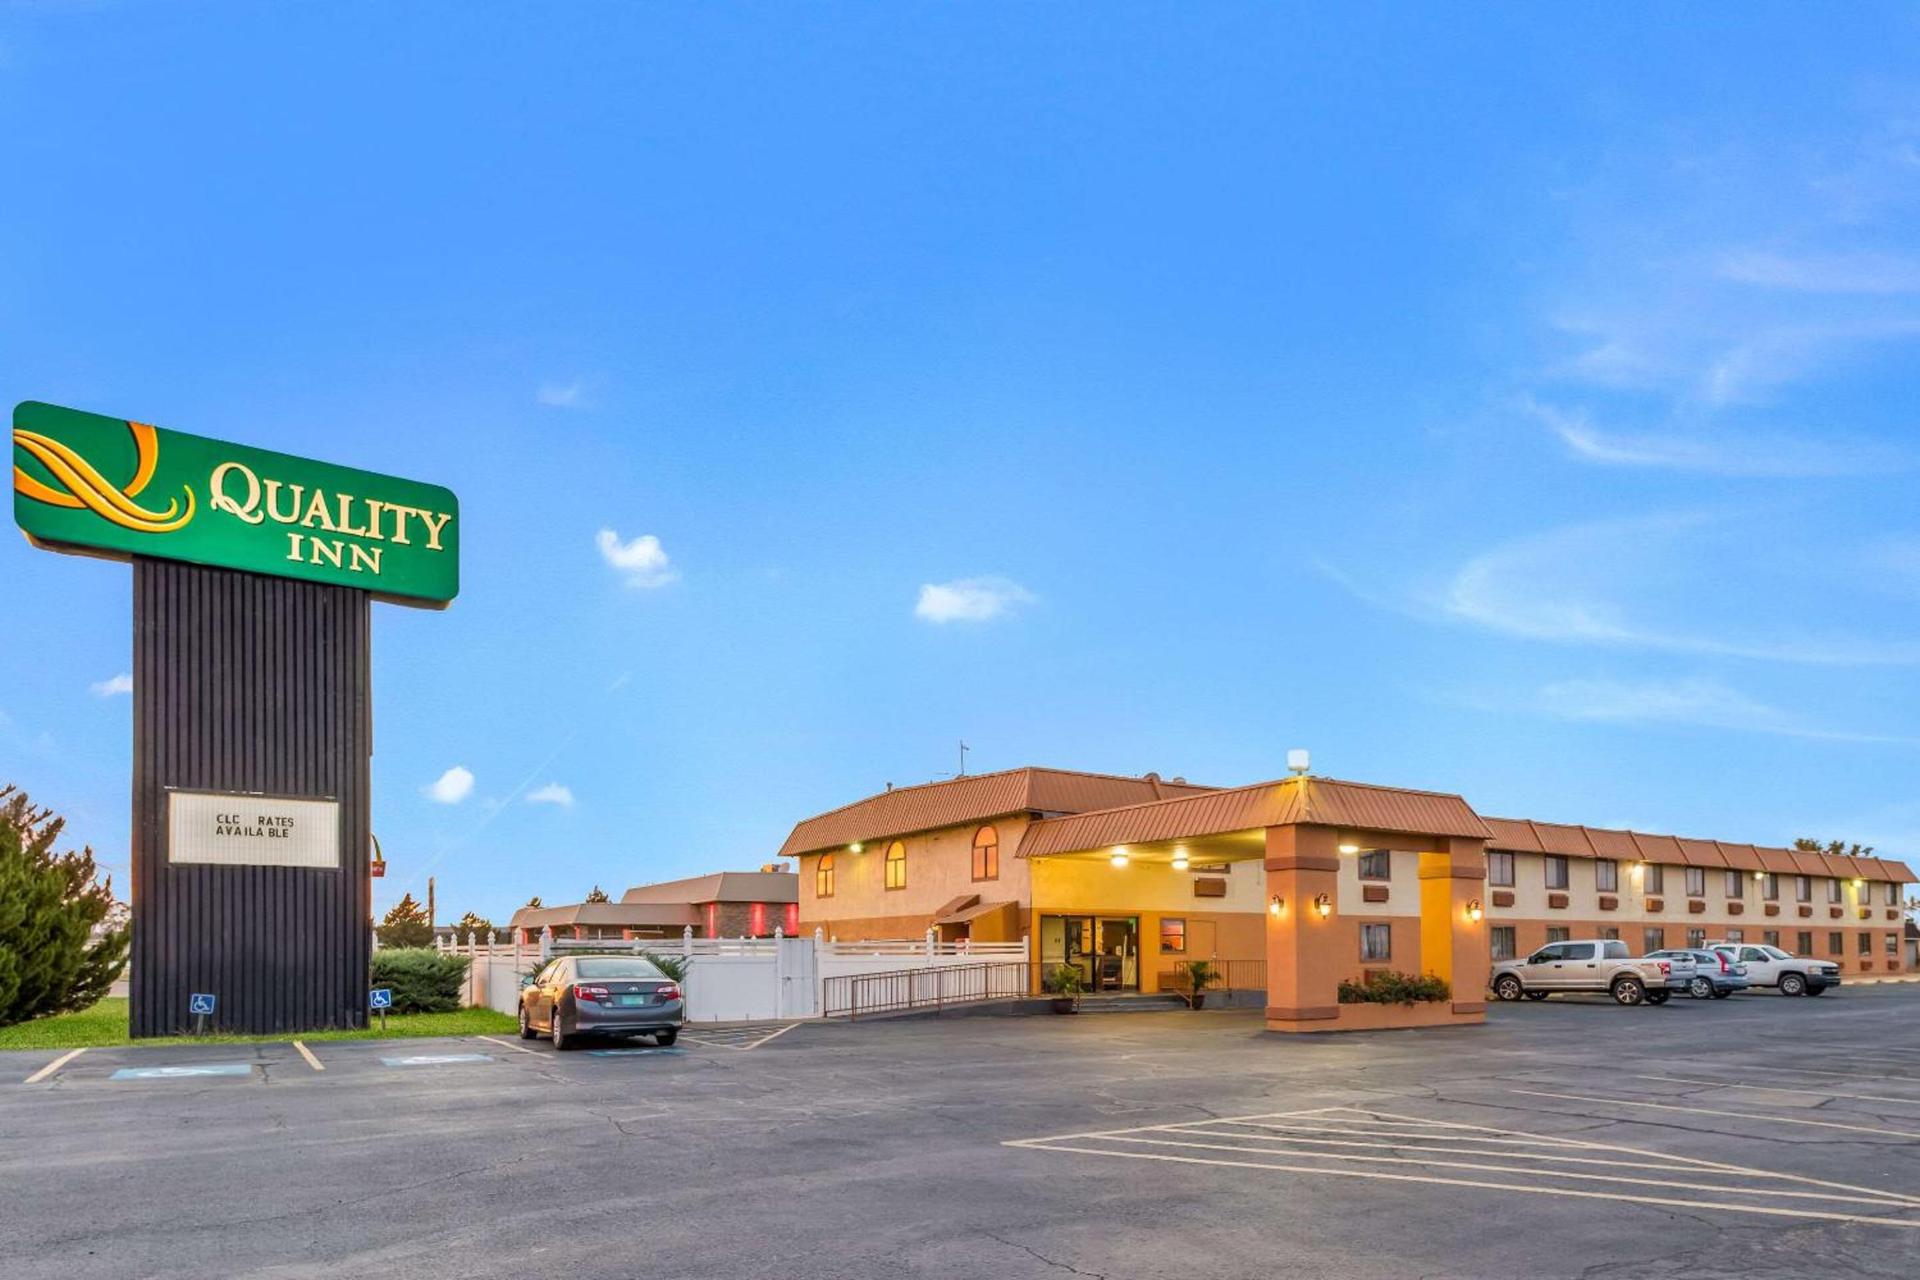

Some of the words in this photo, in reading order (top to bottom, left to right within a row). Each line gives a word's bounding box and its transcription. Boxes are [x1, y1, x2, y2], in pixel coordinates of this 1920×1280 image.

[209, 461, 452, 551] QUALITY
[286, 532, 383, 575] INN
[216, 814, 240, 825] CLC
[258, 815, 294, 828] RATES
[216, 825, 289, 838] AVAILABLE
